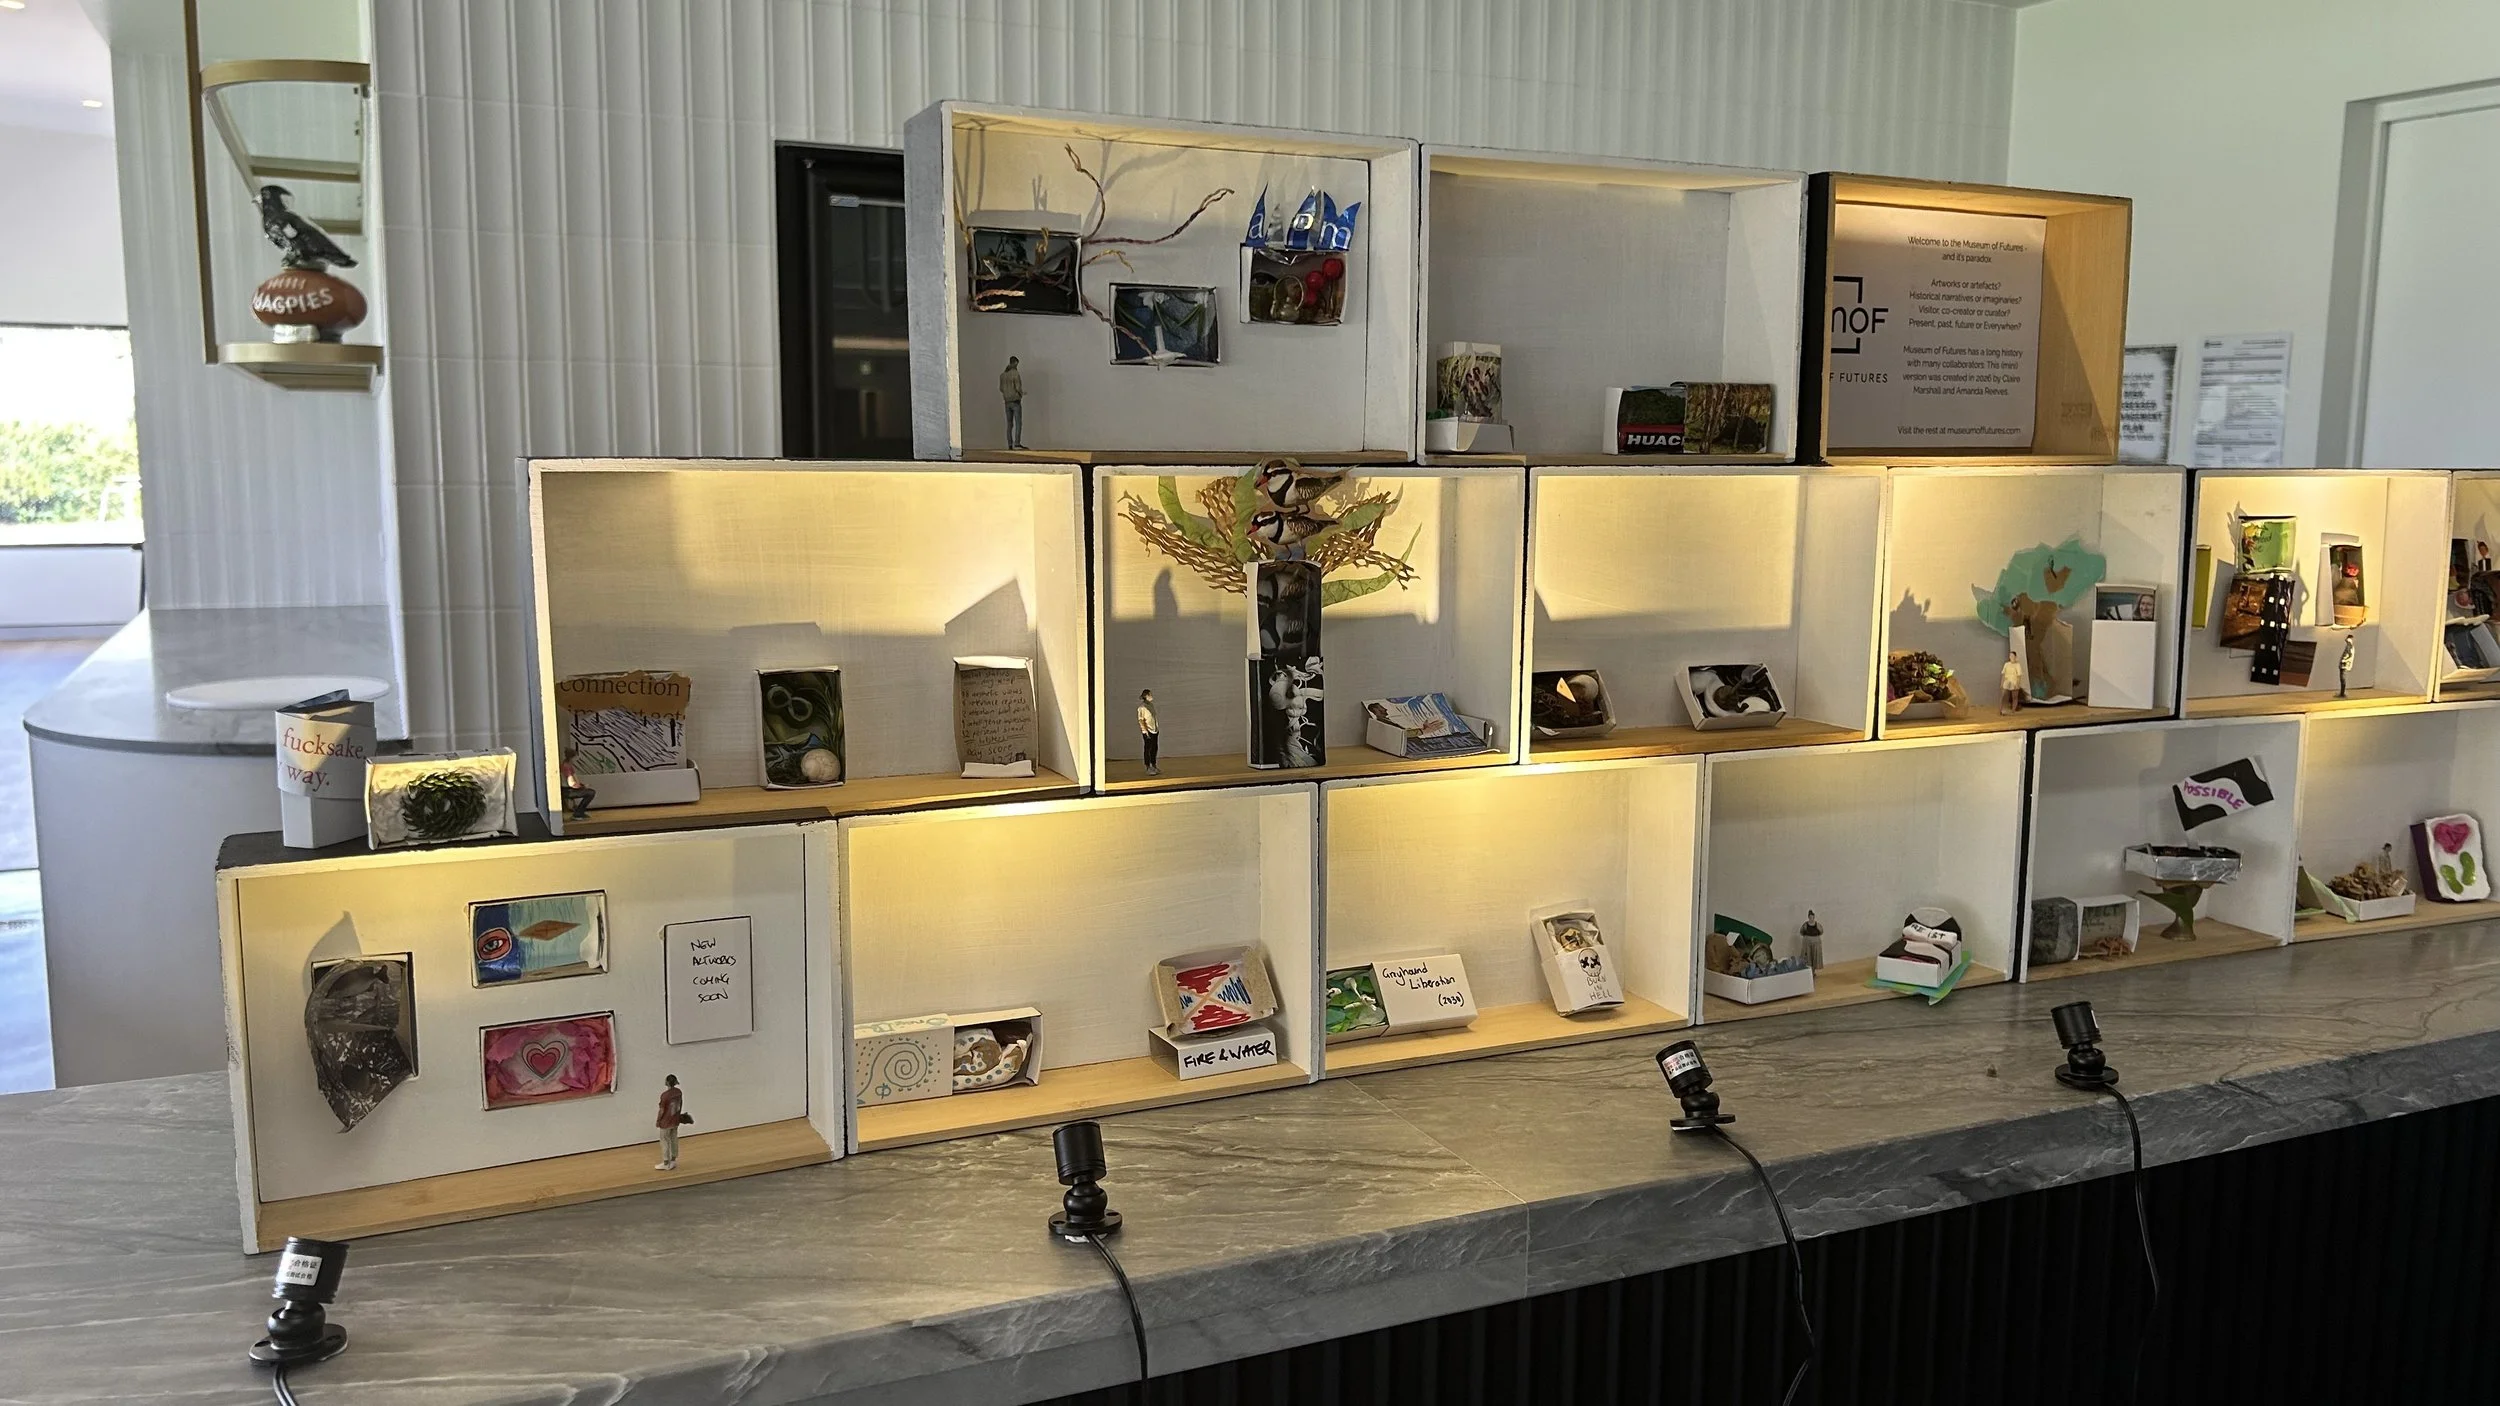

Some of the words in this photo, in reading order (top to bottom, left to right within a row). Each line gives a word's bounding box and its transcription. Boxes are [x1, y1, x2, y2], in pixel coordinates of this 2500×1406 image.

[1908, 236, 1940, 246] Welcome
[1942, 239, 1949, 247] to
[1950, 240, 1961, 248] the
[1963, 240, 1990, 249] Museum
[1992, 242, 1998, 250] of
[1999, 242, 2024, 252] Futures
[1931, 279, 1961, 288] Artworks
[1970, 281, 2001, 290] artefacts?
[1910, 291, 1940, 300] Historical
[1942, 293, 1973, 302] narratives
[1942, 308, 1975, 316] co-creator
[1984, 309, 2010, 317] curator?
[1903, 346, 1932, 354] Museum
[1934, 346, 1941, 354] of
[1942, 347, 1966, 355] Futures
[1986, 348, 2000, 358] long
[2002, 348, 2023, 358] history
[1922, 361, 1940, 369] many
[1988, 361, 2000, 369] This
[1840, 372, 1888, 383] FUTURES
[1943, 374, 1967, 382] created
[1969, 374, 1974, 382] in
[1993, 374, 2000, 384] by
[2002, 375, 2020, 383] Claire
[1913, 386, 1942, 394] Marshall
[1943, 386, 1954, 394] and
[1956, 387, 1983, 395] Amanda
[1898, 426, 1912, 435] Visit
[1913, 427, 1924, 435] the
[1926, 427, 1937, 435] rest
[560, 678, 680, 697] connection
[287, 766, 330, 792] way.
[2184, 780, 2244, 810] POSSIBLE
[690, 938, 716, 951] NEW
[692, 973, 729, 985] COMING
[1382, 962, 1428, 986] Greyhound
[1410, 975, 1456, 990] Liberation
[698, 988, 728, 1004] SOON
[1590, 990, 1613, 1001] HELL
[1184, 1052, 1216, 1068] FIRE
[1228, 1040, 1274, 1061] WATER
